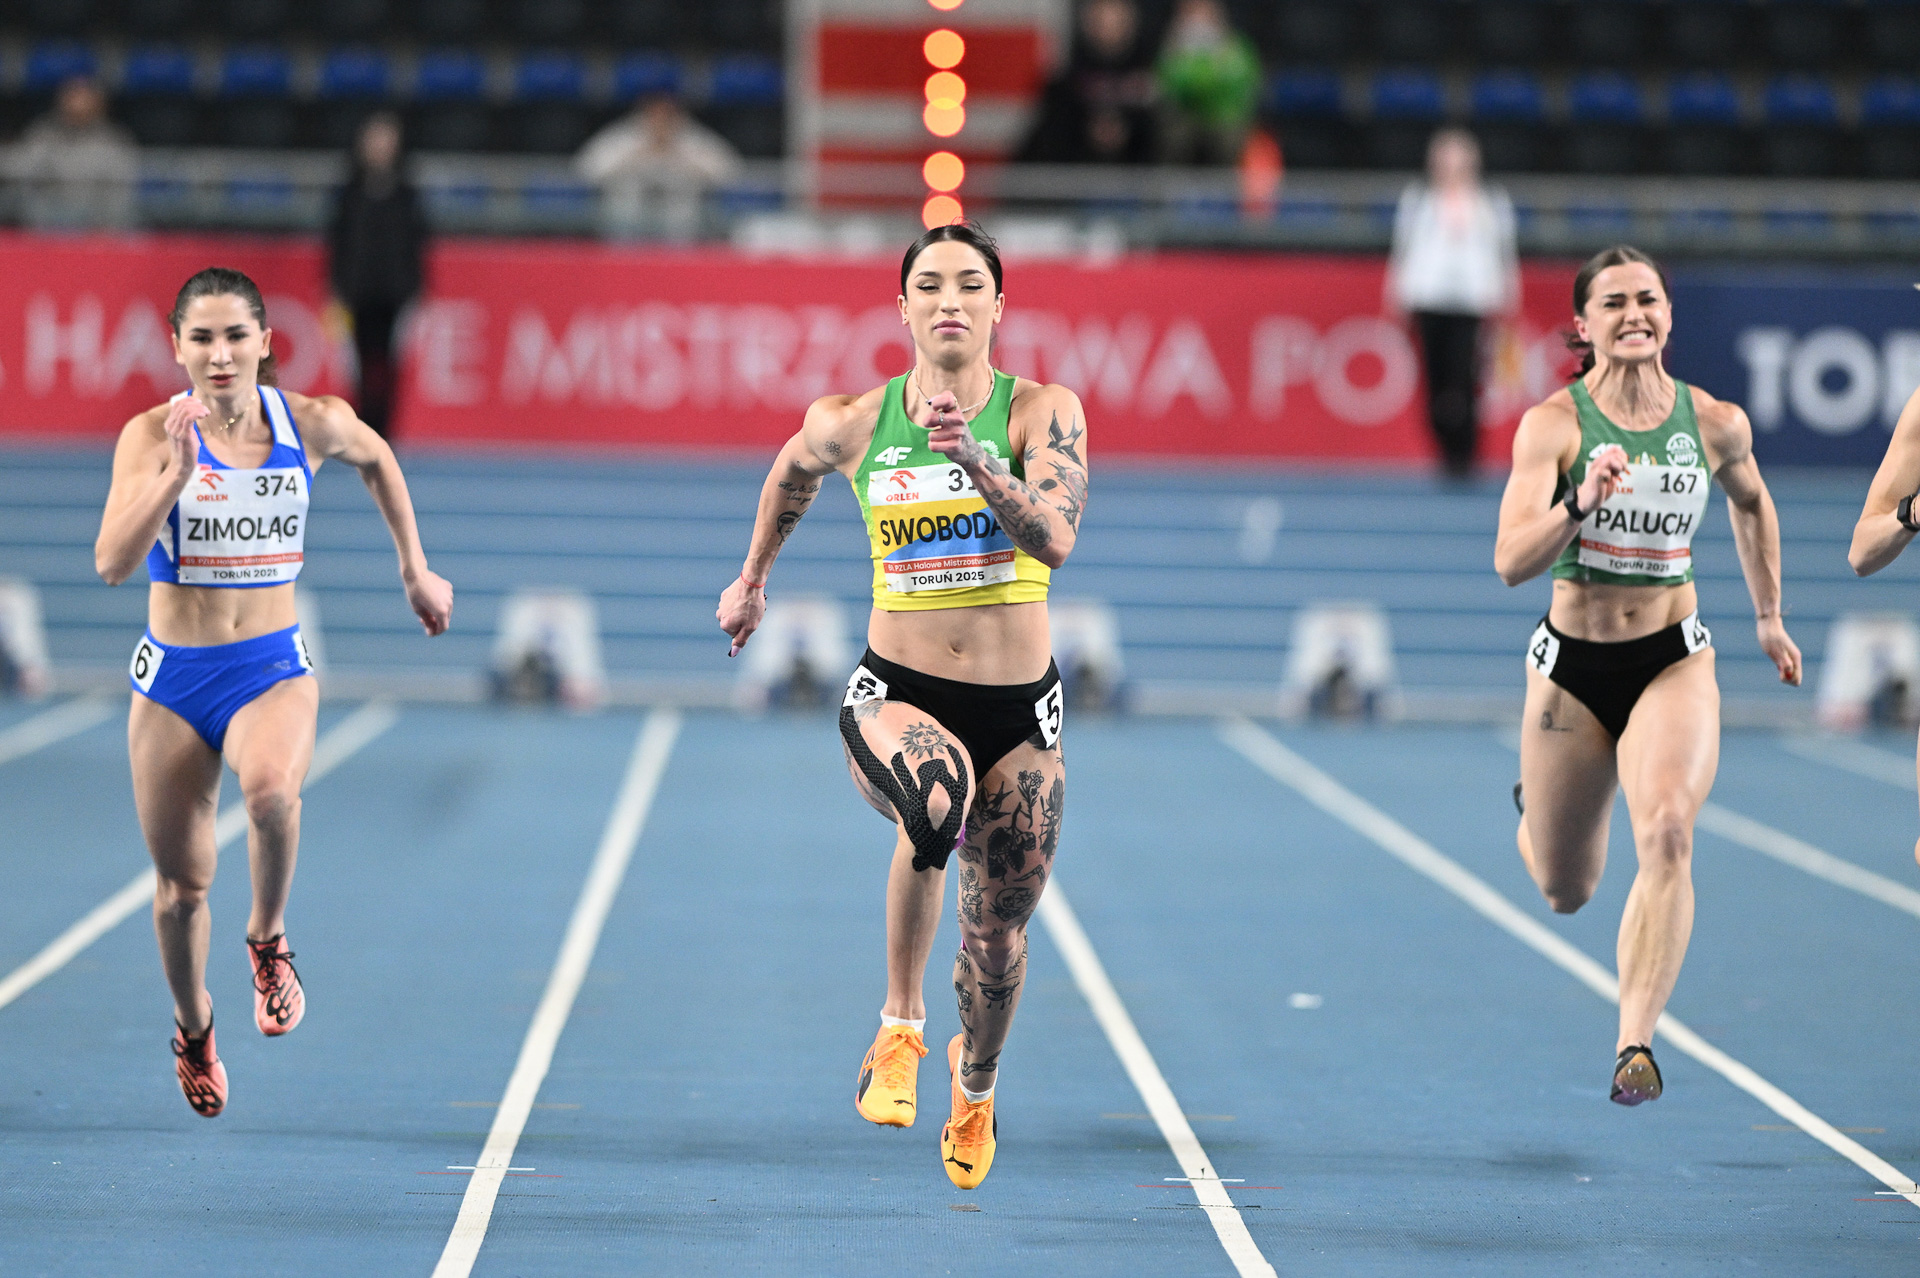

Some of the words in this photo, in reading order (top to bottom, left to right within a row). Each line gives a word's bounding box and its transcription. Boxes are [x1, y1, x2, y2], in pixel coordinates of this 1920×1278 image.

[874, 446, 912, 466] 4F
[255, 475, 298, 497] 374
[1616, 487, 1634, 495] LEN
[1660, 472, 1698, 494] 167
[196, 494, 229, 502] ORLEN
[886, 491, 920, 502] ORLEN
[187, 514, 299, 543] ZIMOLĄG
[1595, 507, 1693, 536] PALUCH
[895, 564, 913, 572] PZLA
[914, 561, 942, 570] Halowe
[943, 558, 989, 568] Mistrzostwa
[990, 552, 1011, 563] Polski
[213, 567, 251, 579] TORUŃ
[911, 570, 953, 586] TORUŃ
[956, 571, 985, 582] 2025
[135, 643, 153, 680] 6
[1532, 636, 1549, 669] 4
[1046, 690, 1060, 735] 5
